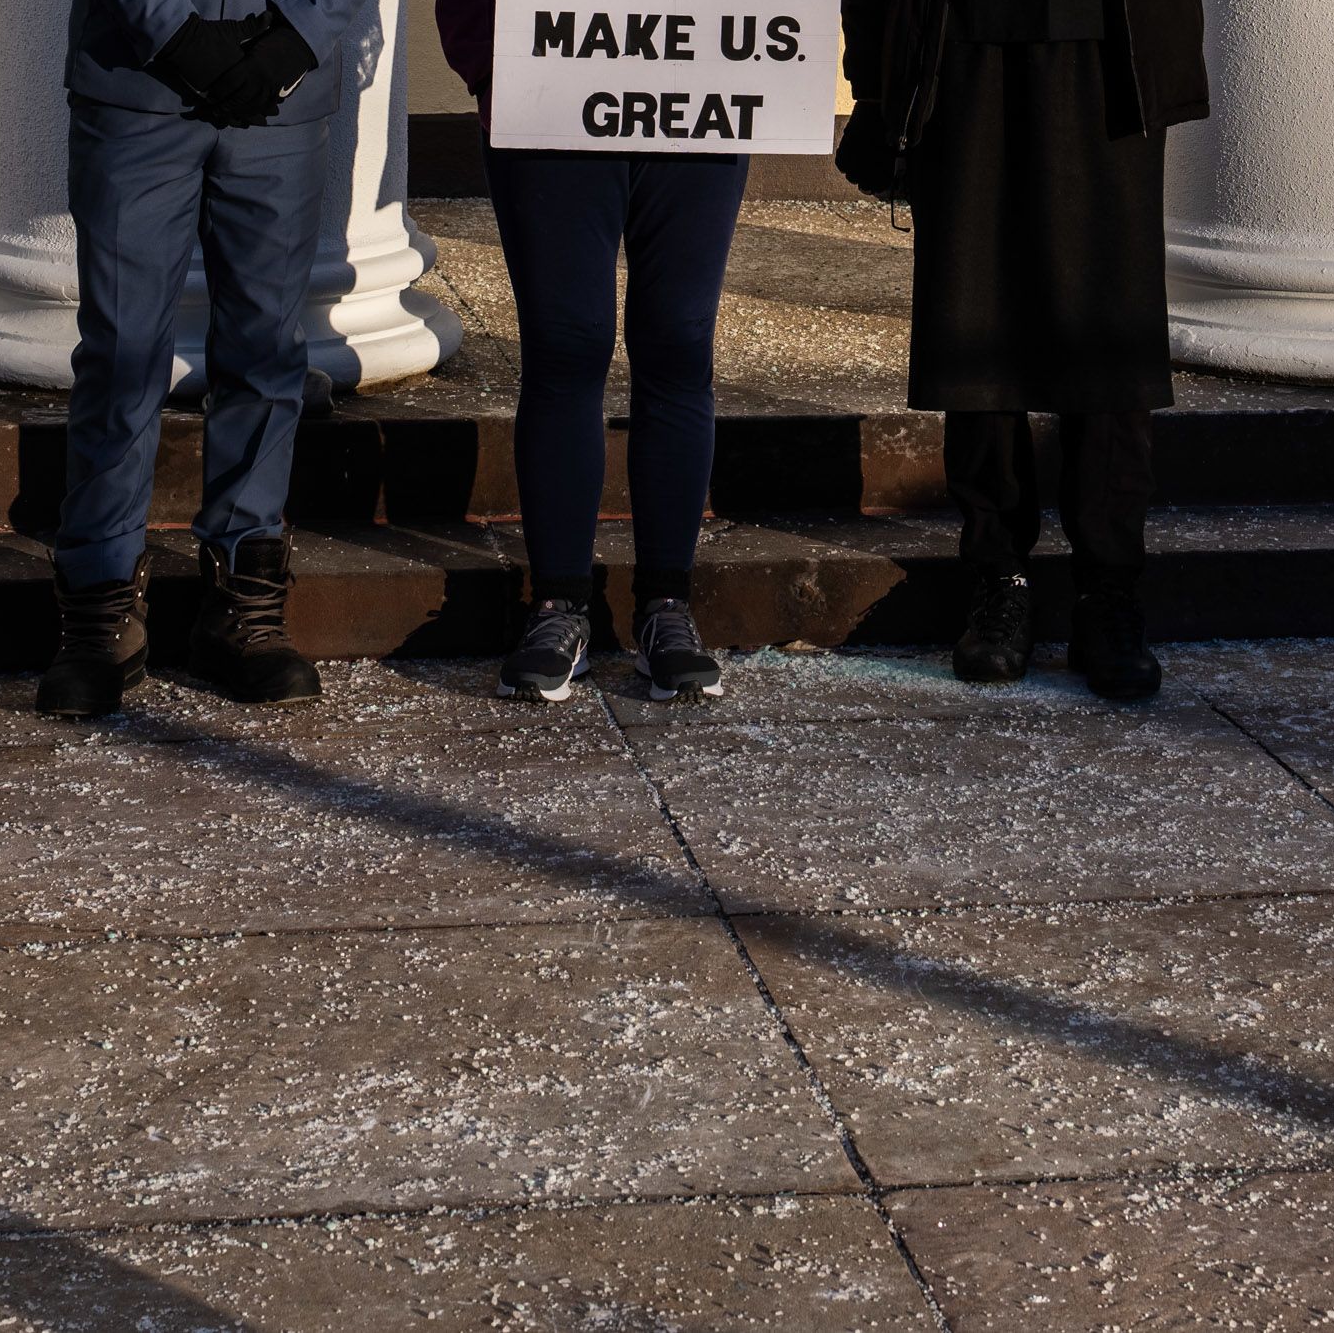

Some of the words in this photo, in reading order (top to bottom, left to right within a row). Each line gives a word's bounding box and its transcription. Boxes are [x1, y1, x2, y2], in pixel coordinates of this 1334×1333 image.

[532, 11, 696, 61] MAKE
[720, 15, 806, 62] U.S.
[582, 91, 764, 141] GREAT
